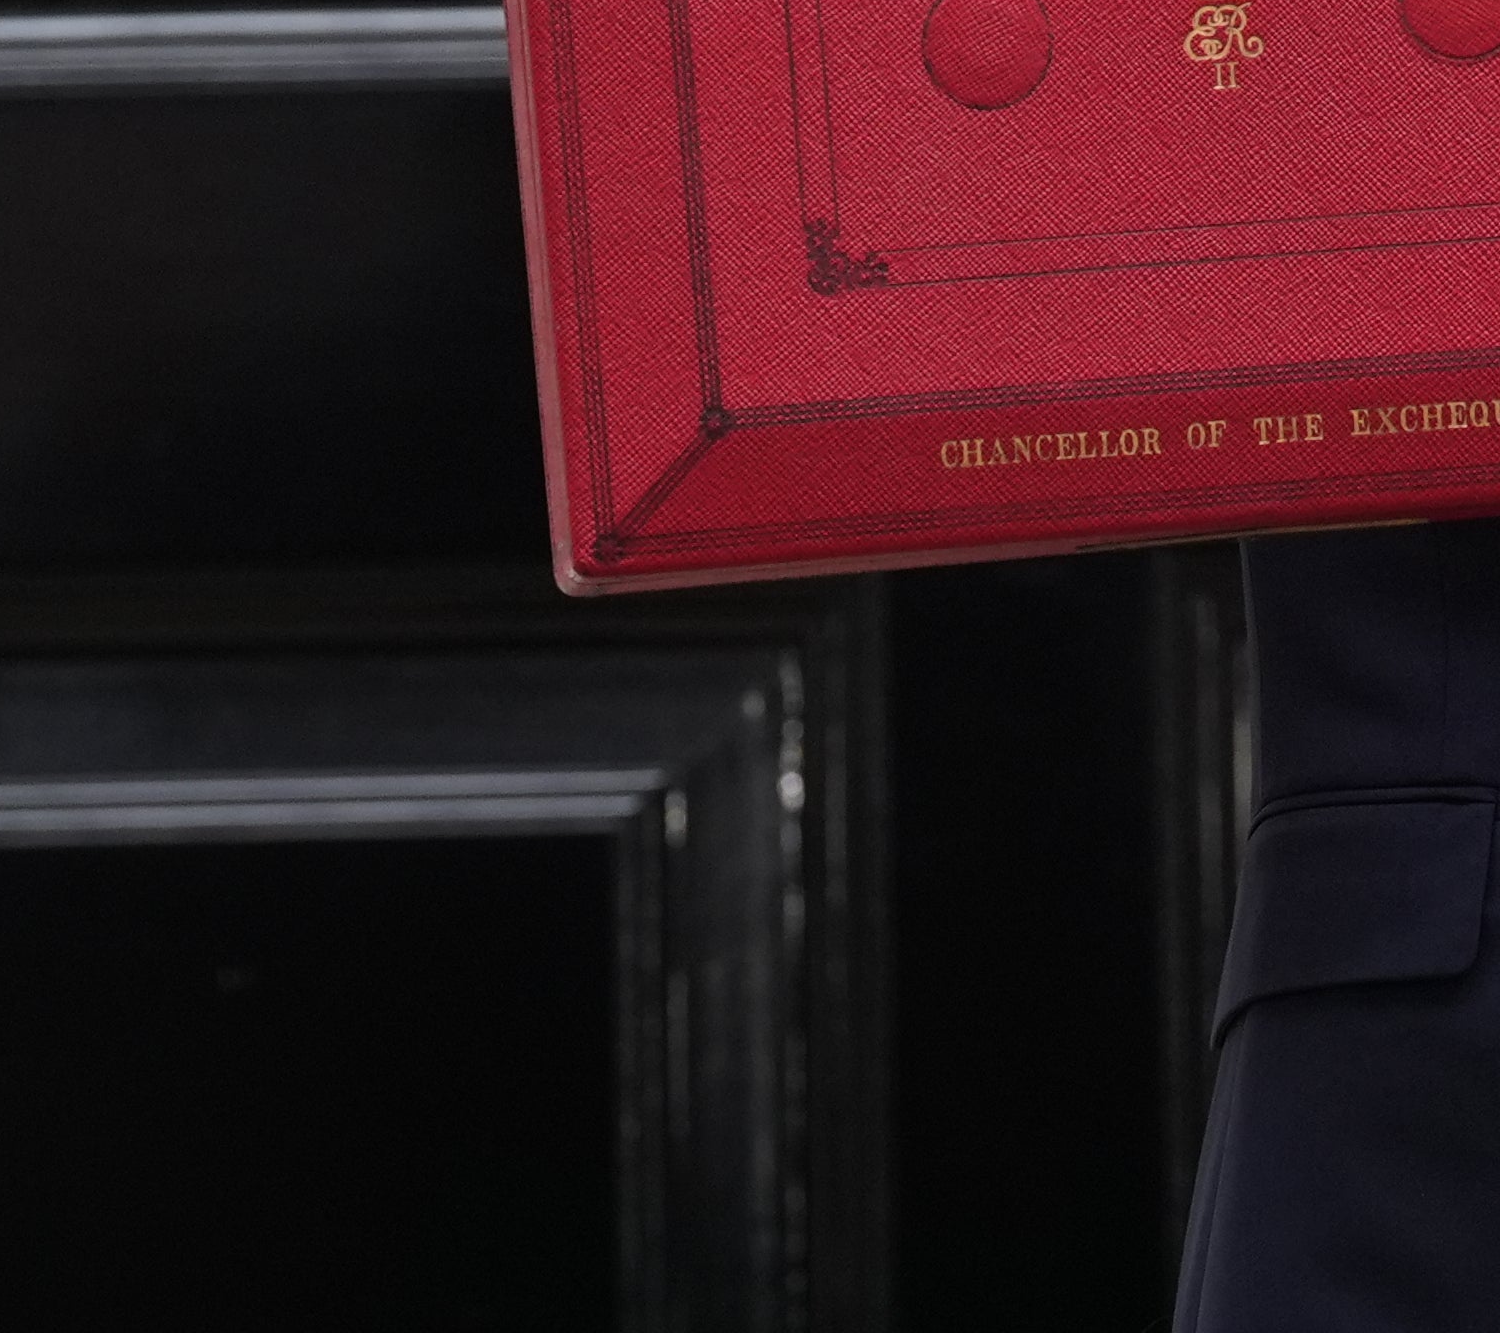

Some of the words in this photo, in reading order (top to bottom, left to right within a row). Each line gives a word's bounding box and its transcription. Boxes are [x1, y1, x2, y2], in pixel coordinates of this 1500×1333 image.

[1213, 62, 1240, 90] II
[940, 427, 1162, 468] CHANCELLOR
[1187, 421, 1227, 449] OF
[1253, 413, 1323, 445] THE
